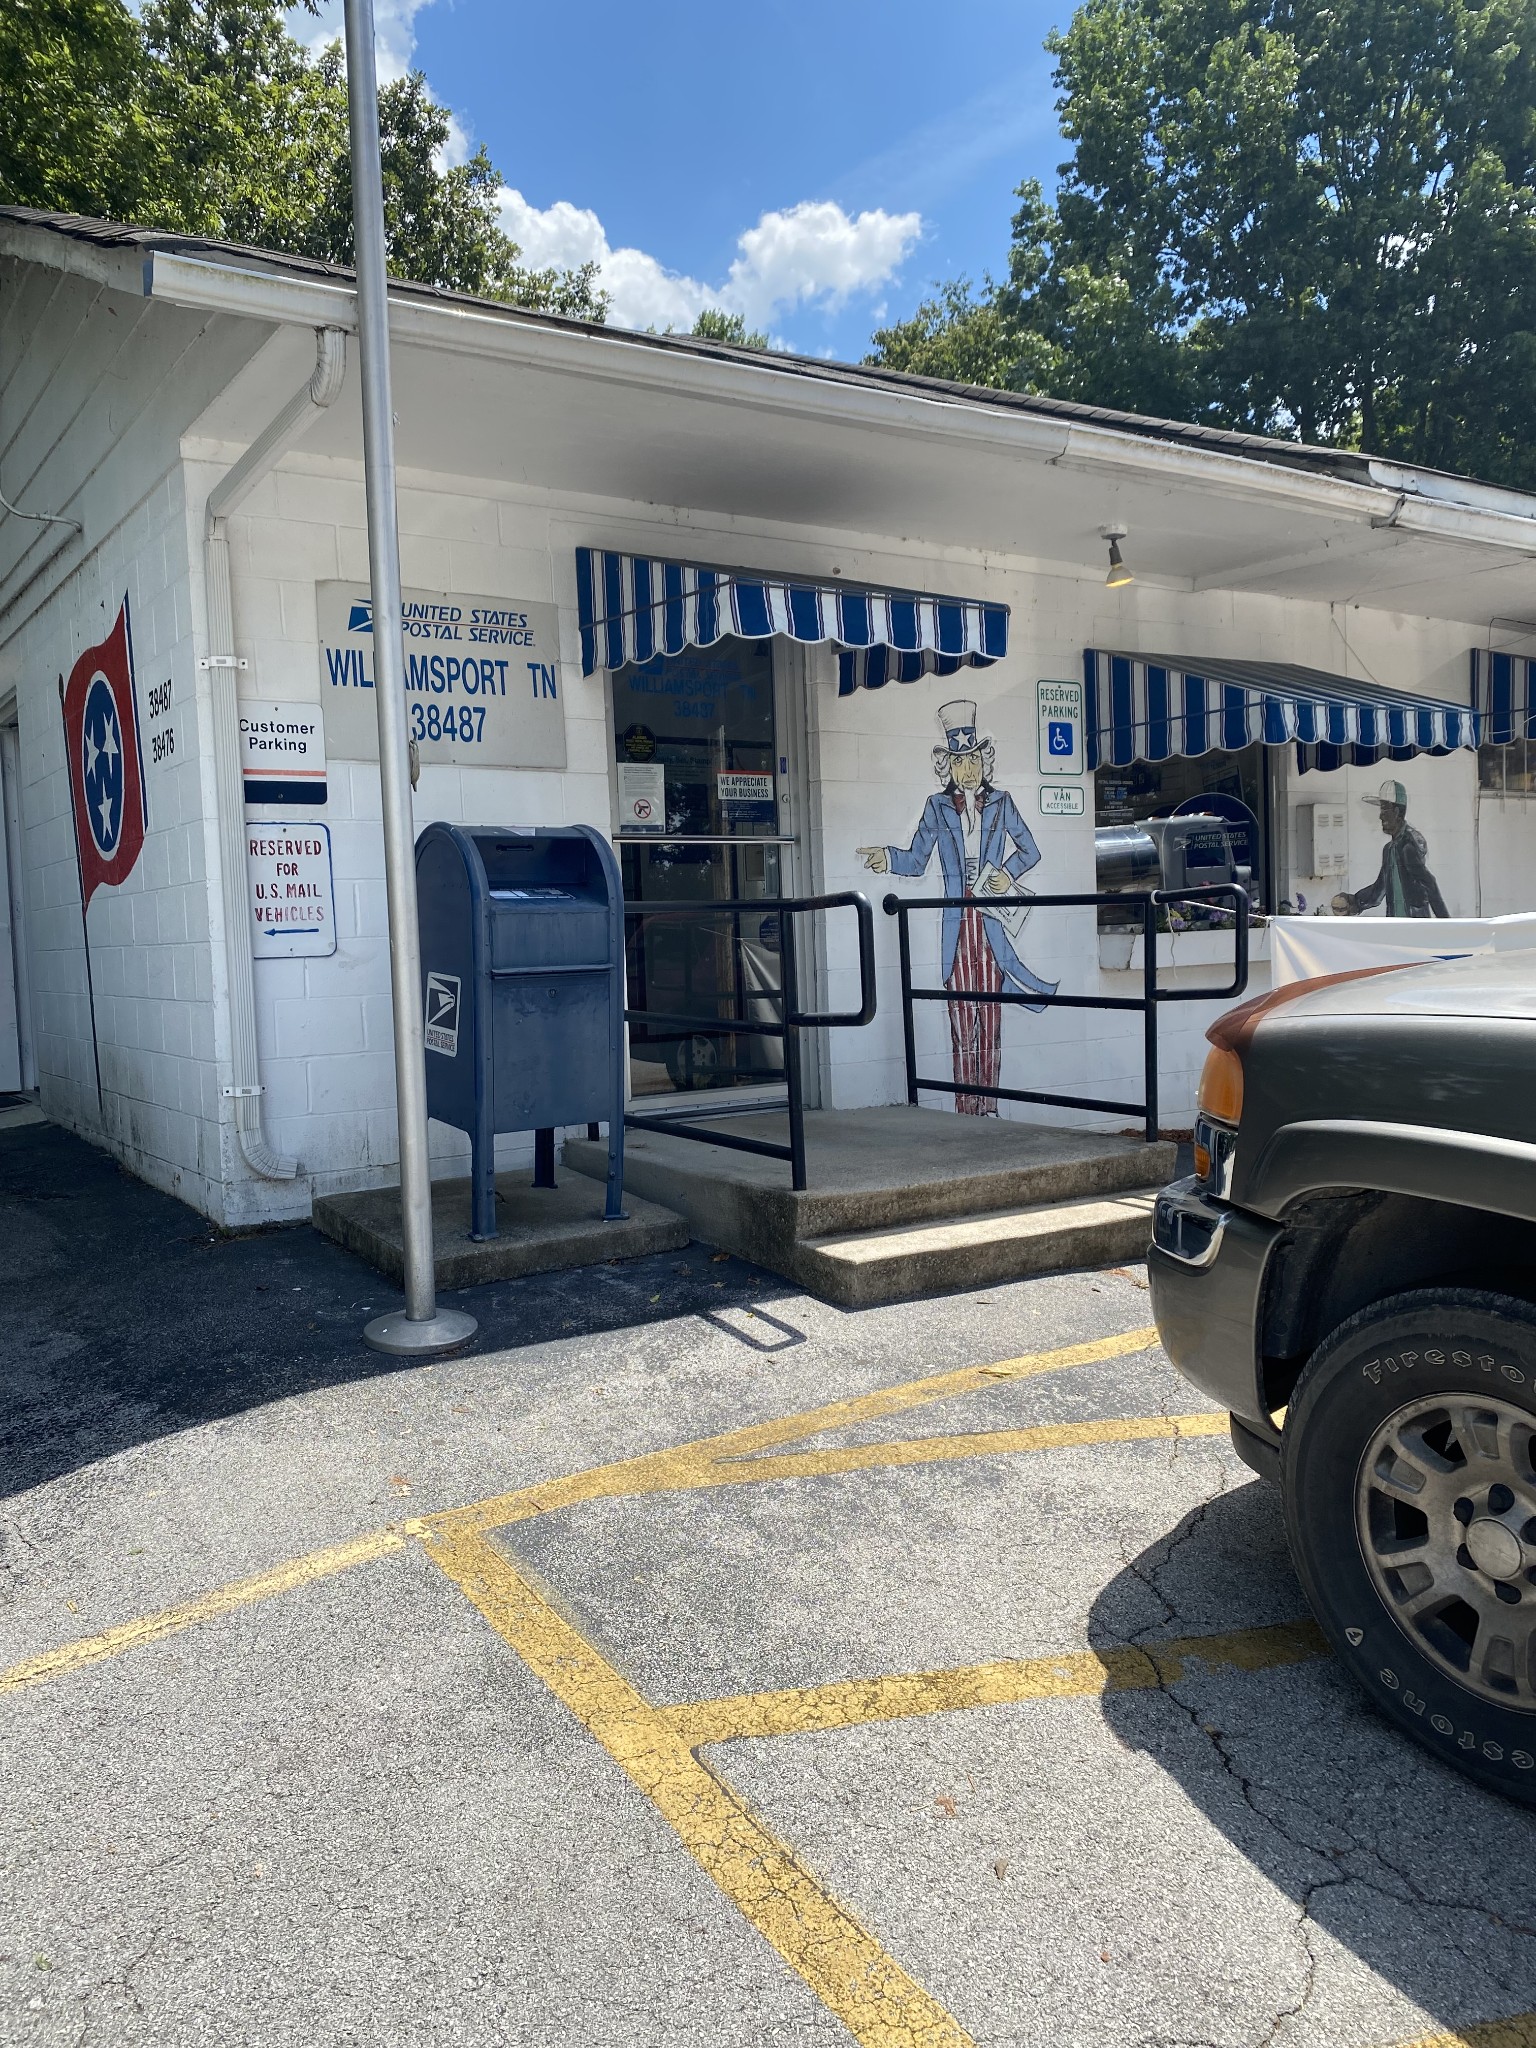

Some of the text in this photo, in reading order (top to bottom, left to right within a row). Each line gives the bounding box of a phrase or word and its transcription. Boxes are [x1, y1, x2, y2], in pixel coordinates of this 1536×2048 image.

[402, 602, 528, 628] UNITED STATES
[468, 627, 534, 646] SERVICE
[326, 648, 557, 699] WILMSPORT TN
[149, 679, 172, 719] 38487
[1040, 688, 1079, 702] RESERVED
[1042, 705, 1078, 718] PARKING
[240, 718, 315, 735] Customer
[412, 703, 486, 742] 38487
[152, 728, 174, 763] 38476
[250, 737, 307, 753] Parking
[720, 776, 768, 787] WE APPRECIATE
[720, 788, 769, 798] YOUR BUSINESS
[1054, 792, 1071, 801] VAN
[1046, 802, 1078, 810] ACCESSIBLE
[1194, 840, 1248, 849] POSTAL SERVICE
[1195, 832, 1246, 841] UNITED STATES
[250, 840, 322, 856] RESERVED
[276, 862, 299, 876] FOR
[256, 884, 322, 900] U.S. MAIL
[254, 906, 325, 922] VEHICLES
